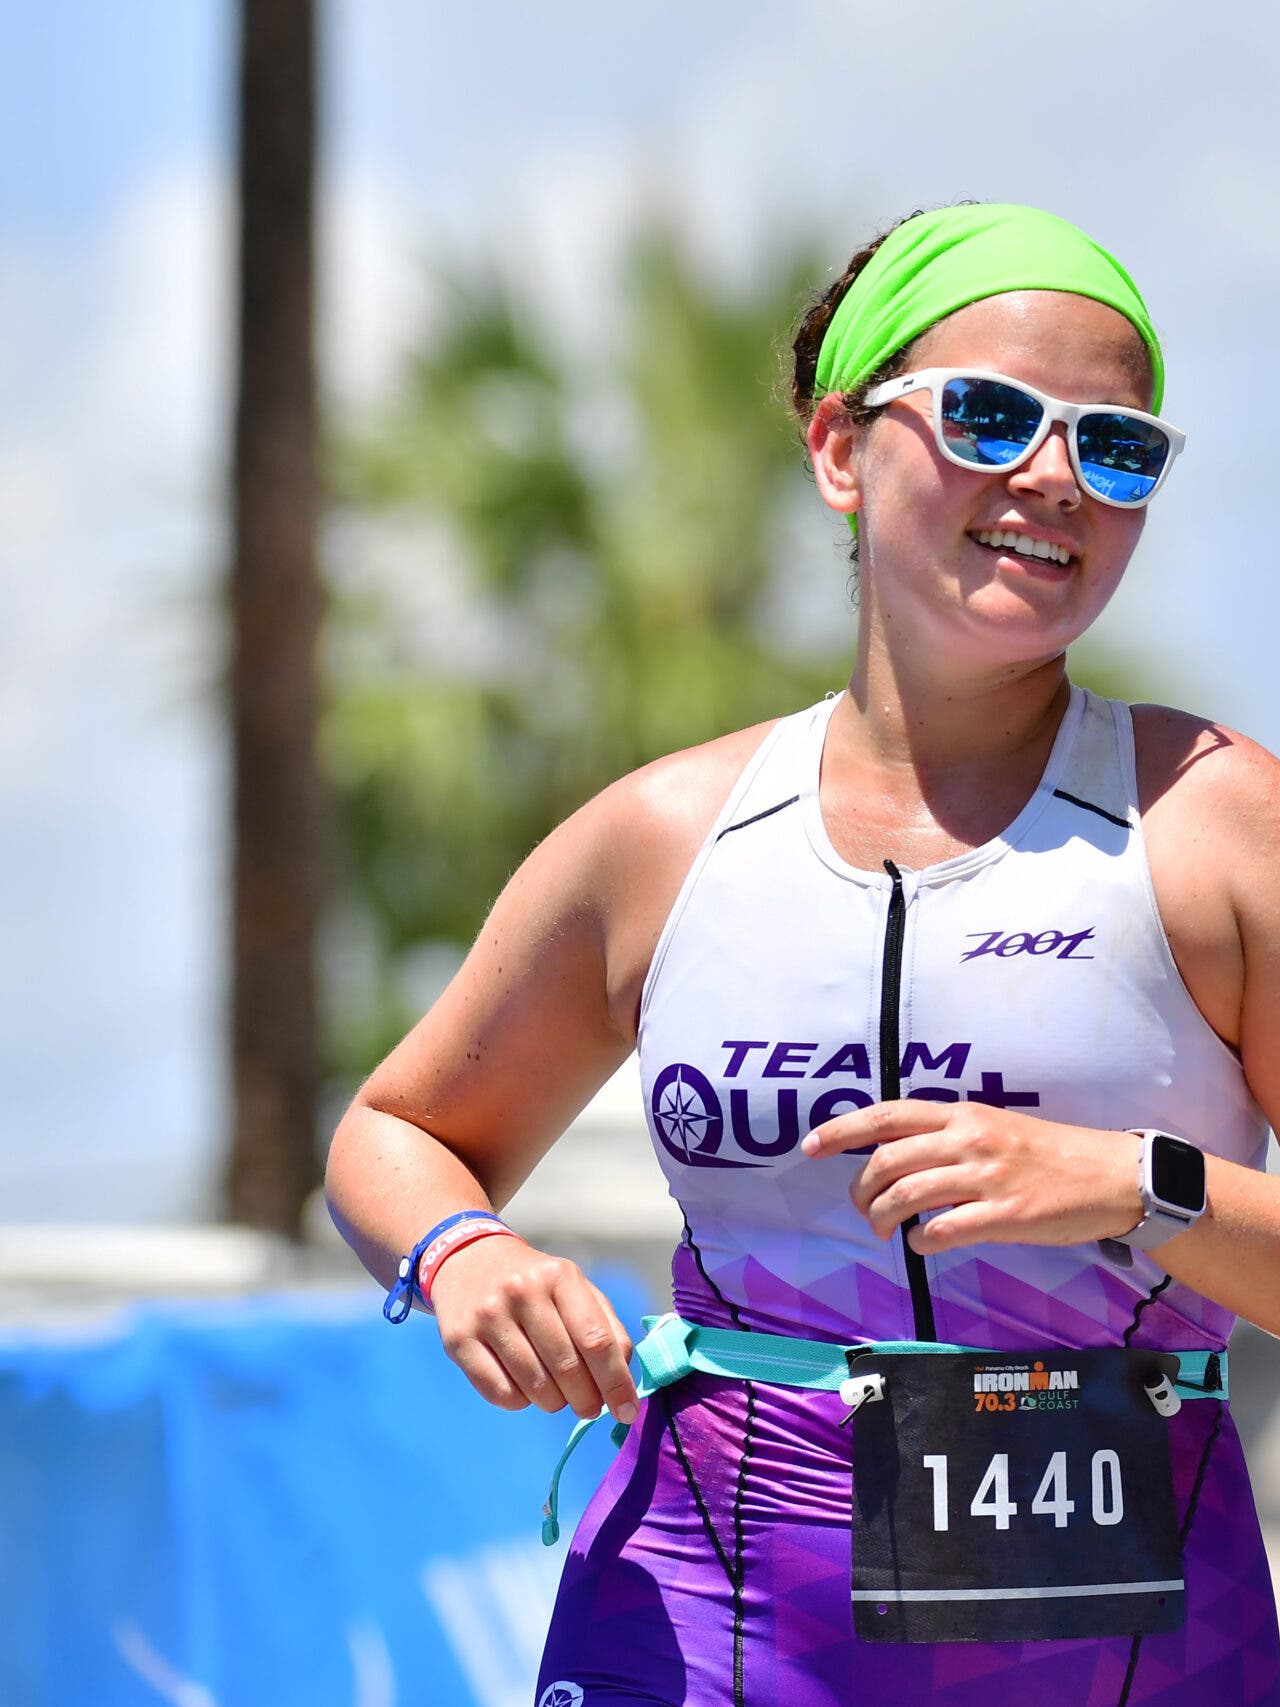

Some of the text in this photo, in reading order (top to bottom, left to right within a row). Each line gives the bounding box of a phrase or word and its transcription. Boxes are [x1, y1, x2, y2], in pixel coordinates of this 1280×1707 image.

[720, 1041, 972, 1079] TEAM
[974, 1362, 1079, 1392] IRONMAN
[974, 1393, 1016, 1412] 70.3
[1038, 1391, 1069, 1400] GULF
[1038, 1400, 1079, 1410] COAST
[923, 1449, 1124, 1531] 1440
